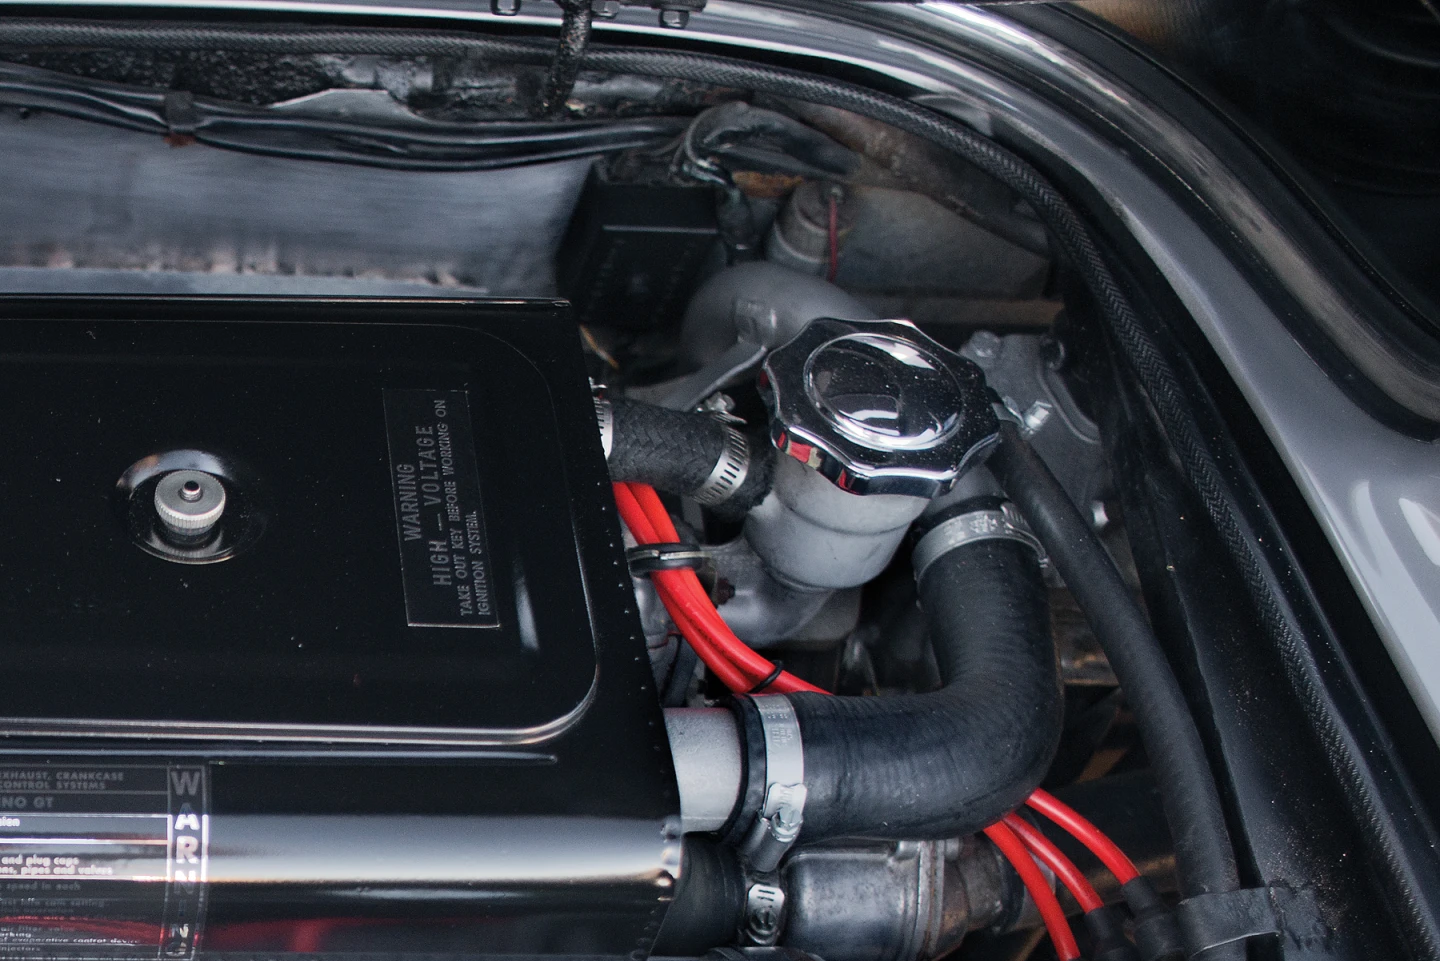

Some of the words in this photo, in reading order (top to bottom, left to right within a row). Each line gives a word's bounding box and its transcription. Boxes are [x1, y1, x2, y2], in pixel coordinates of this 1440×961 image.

[434, 400, 446, 418] ON
[437, 422, 454, 476] WORKING
[416, 426, 441, 506] VOLTAGE
[396, 464, 422, 541] WARNING
[444, 481, 460, 522] BEFORE
[450, 528, 463, 551] KEY
[465, 510, 483, 555] SYSTEM.
[429, 540, 452, 587] HIGH
[453, 554, 468, 579] OUT
[456, 584, 473, 617] TAKE
[472, 561, 491, 616] IGNITION
[56, 771, 124, 782] CRANKCASE
[56, 780, 106, 790] SYSTEMS
[34, 797, 54, 809] GT
[1, 854, 23, 865] and
[25, 854, 51, 867] plug
[53, 856, 80, 868] caps
[20, 865, 51, 877] pipes
[53, 865, 76, 876] and
